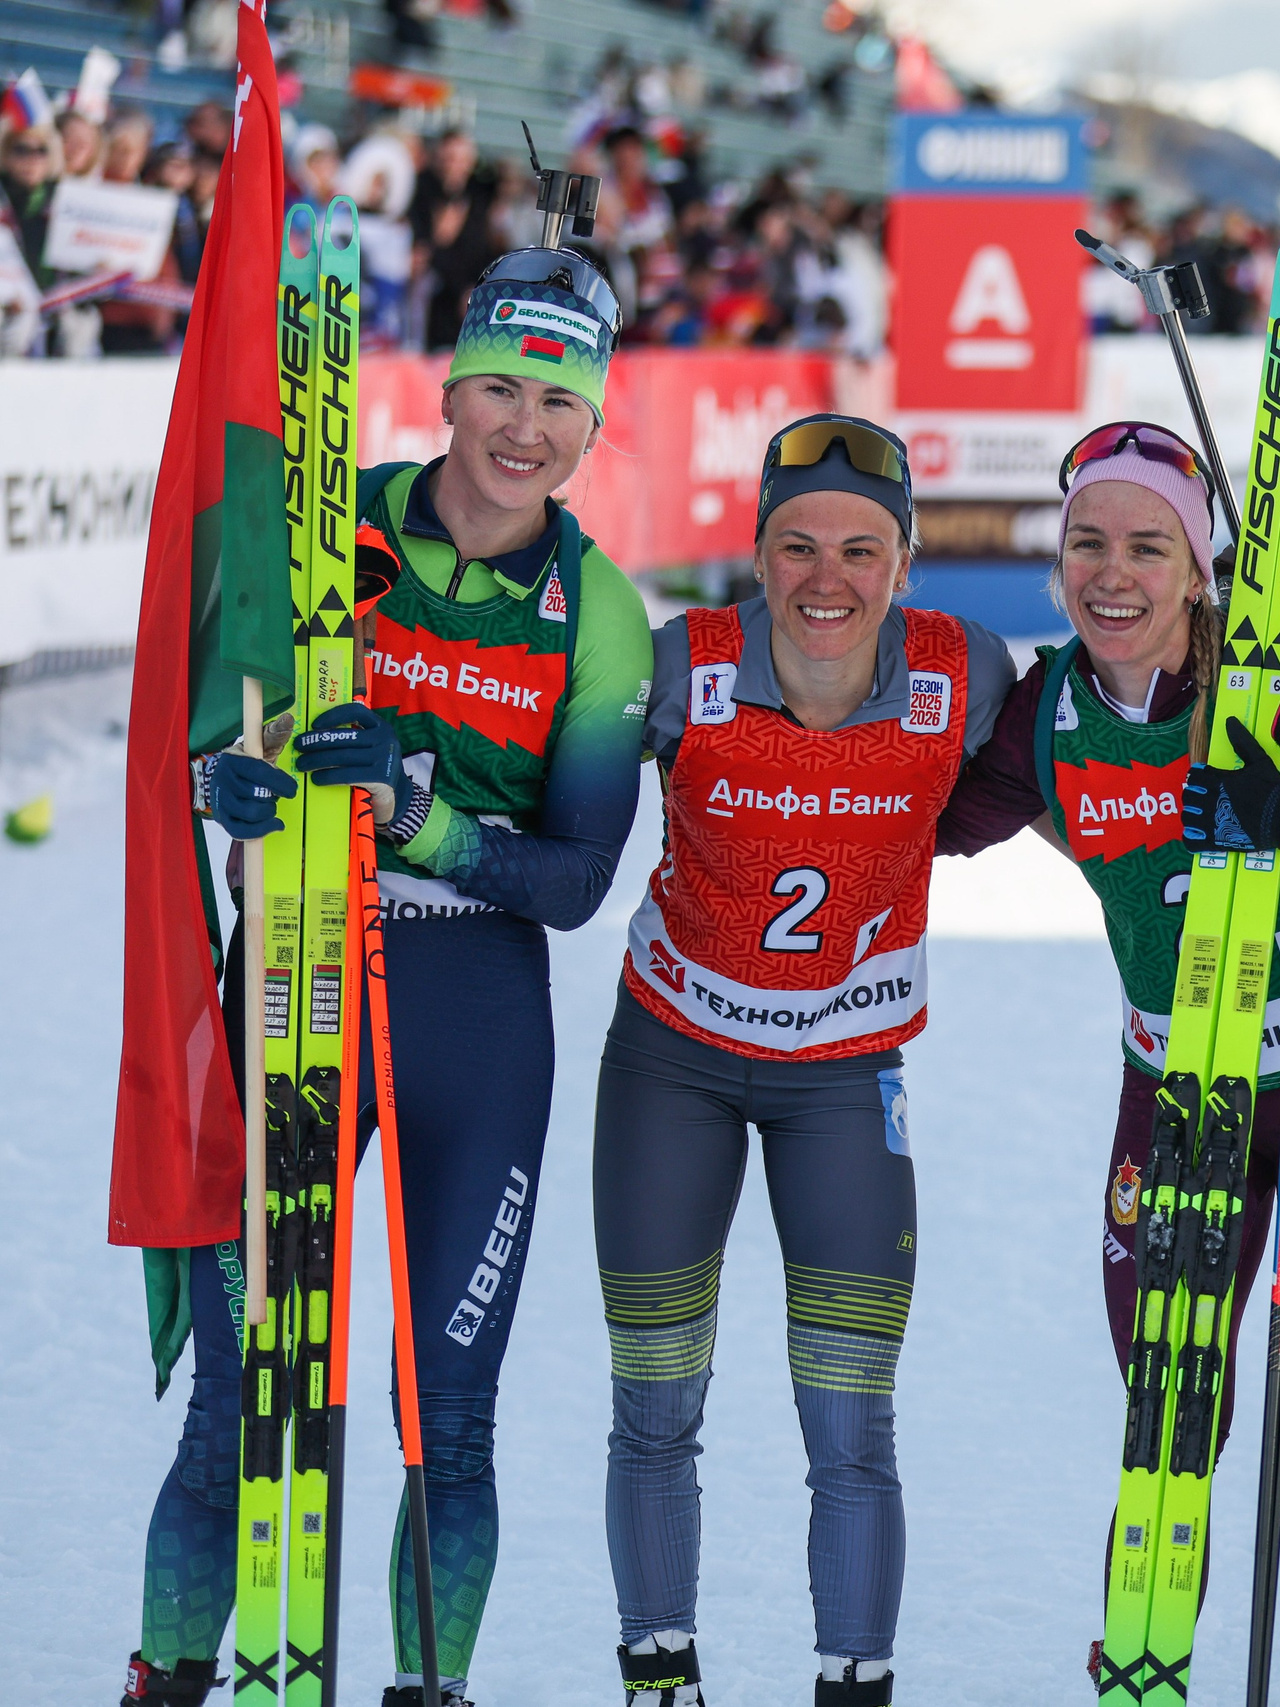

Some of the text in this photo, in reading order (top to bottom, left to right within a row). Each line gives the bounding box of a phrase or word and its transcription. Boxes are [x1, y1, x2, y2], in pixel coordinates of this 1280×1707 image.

[518, 308, 597, 340] БЕЛОРУСНЕФТЬ
[320, 274, 352, 564] FISCHER
[545, 596, 567, 614] 202
[371, 650, 542, 712] льфа Банк
[912, 679, 943, 694] СЕЗОН
[1230, 675, 1244, 688] 63
[623, 704, 647, 715] BEE
[909, 710, 941, 726] 2026
[911, 694, 942, 710] 2025
[707, 778, 913, 820] Альфа Банк
[1078, 787, 1178, 826] Альфа
[761, 865, 830, 953] 2
[691, 977, 912, 1030] ТЕХНОНИКОЛЬ
[383, 1051, 395, 1108] PREMIO
[467, 1166, 529, 1304] BEEU
[623, 1676, 686, 1690] SCHER
